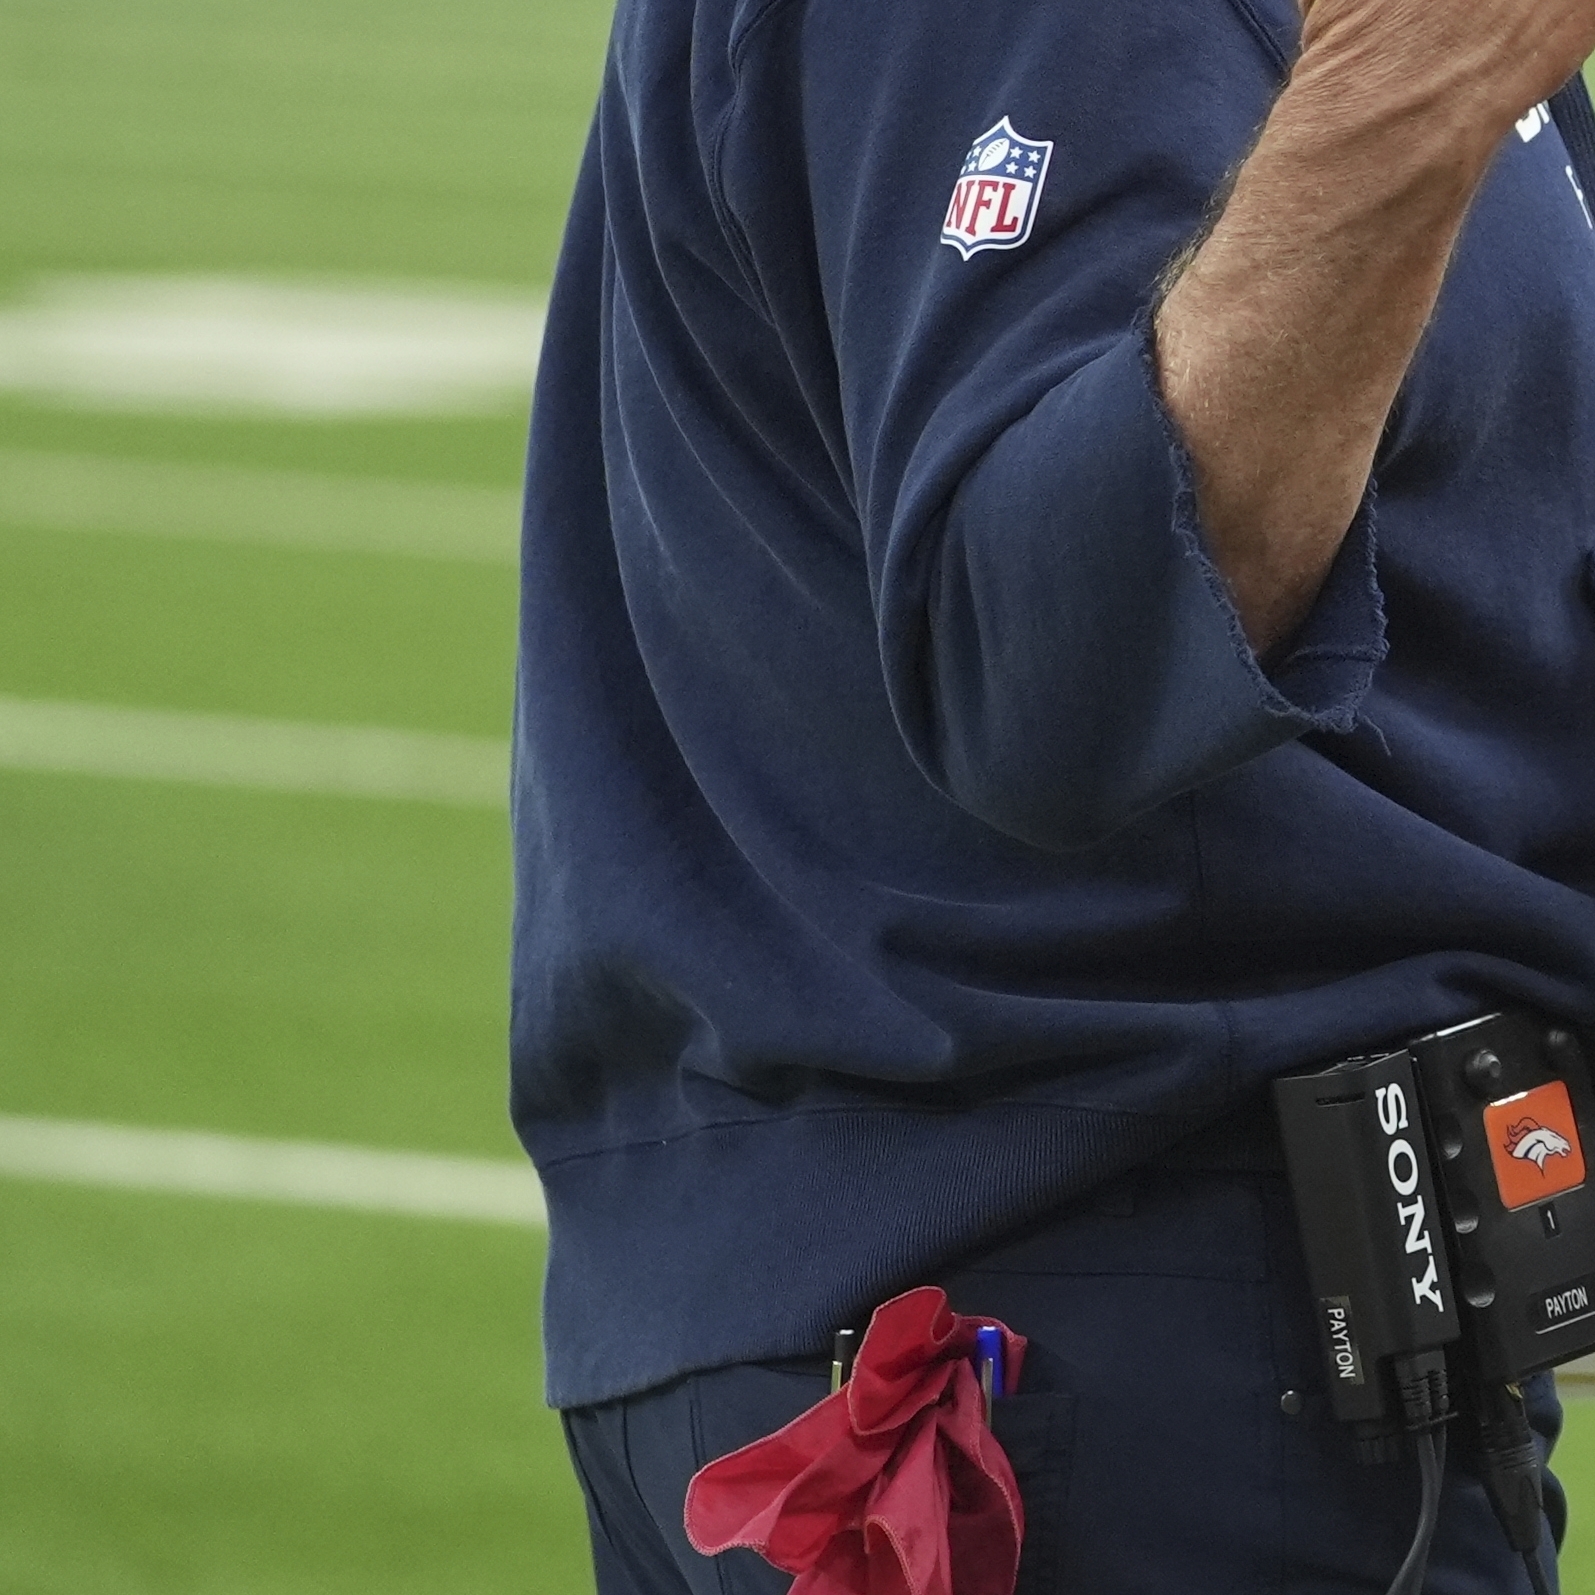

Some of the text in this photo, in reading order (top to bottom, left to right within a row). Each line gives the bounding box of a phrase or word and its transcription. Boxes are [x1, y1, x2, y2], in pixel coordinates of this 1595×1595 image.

[946, 179, 1019, 237] NFL
[1374, 1082, 1445, 1313] SONY
[1545, 1285, 1589, 1319] PAYTON
[1327, 1307, 1356, 1378] PAYTON
